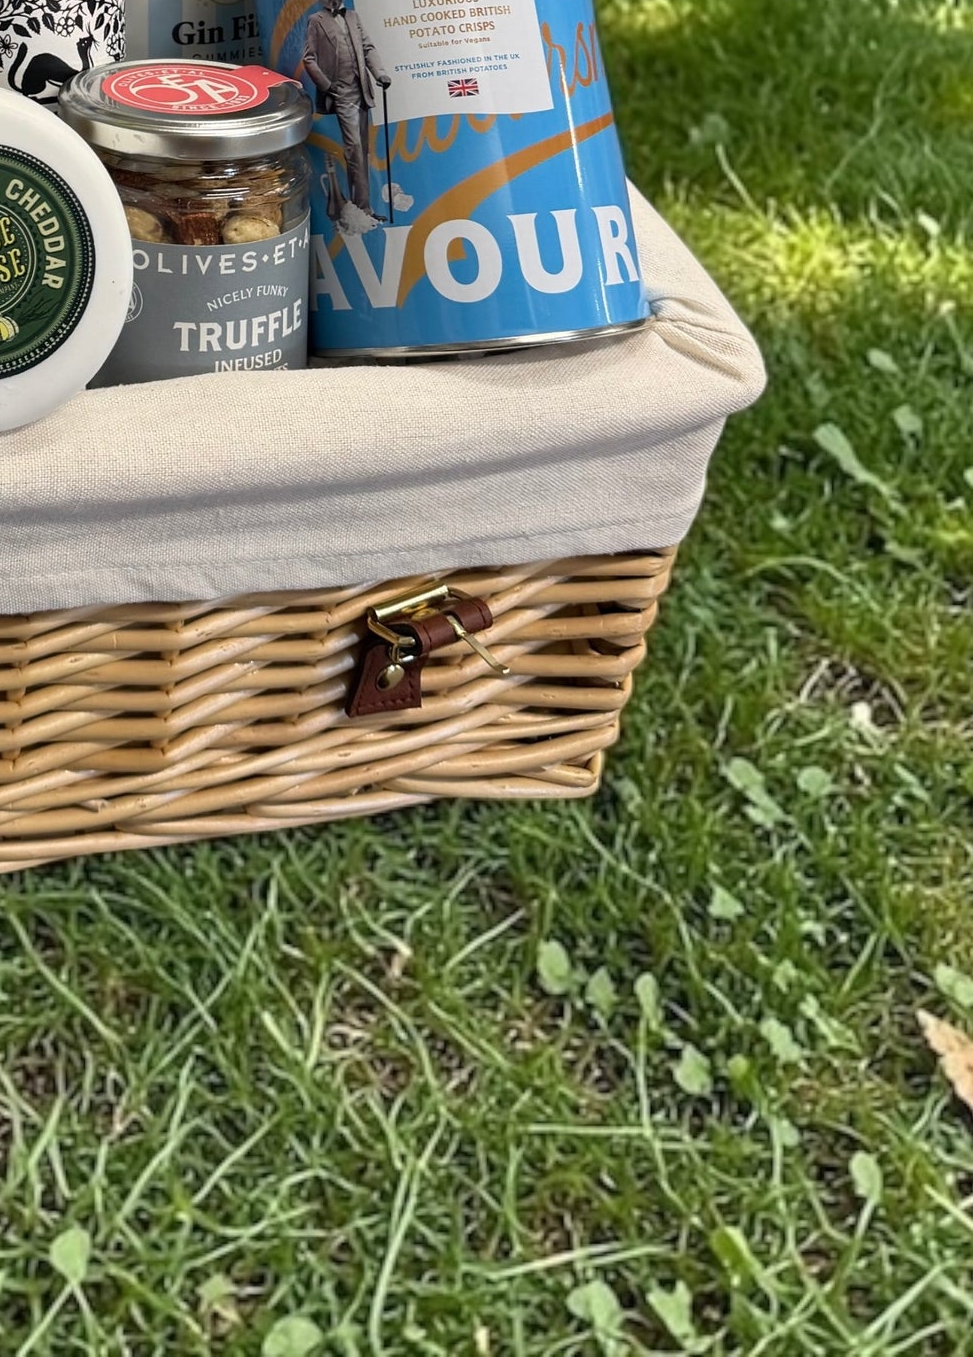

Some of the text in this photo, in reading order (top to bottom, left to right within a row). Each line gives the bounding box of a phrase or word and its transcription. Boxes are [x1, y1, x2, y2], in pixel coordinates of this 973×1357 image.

[383, 5, 511, 28] HAND COOKED BRITISH
[171, 20, 225, 45] Gin
[409, 21, 495, 39] POTATO CRISPS
[418, 39, 449, 49] Suitable
[464, 36, 491, 45] Vegans
[394, 61, 435, 72] STYLISHLY
[437, 56, 482, 67] FASHIONED
[411, 64, 508, 80] FROM BRITISH POTATOES
[4, 178, 67, 290] CHEDDAR
[206, 284, 289, 312] NICELY FUNKY
[173, 298, 302, 352] TRUFFLE
[214, 348, 282, 373] INFUSED
